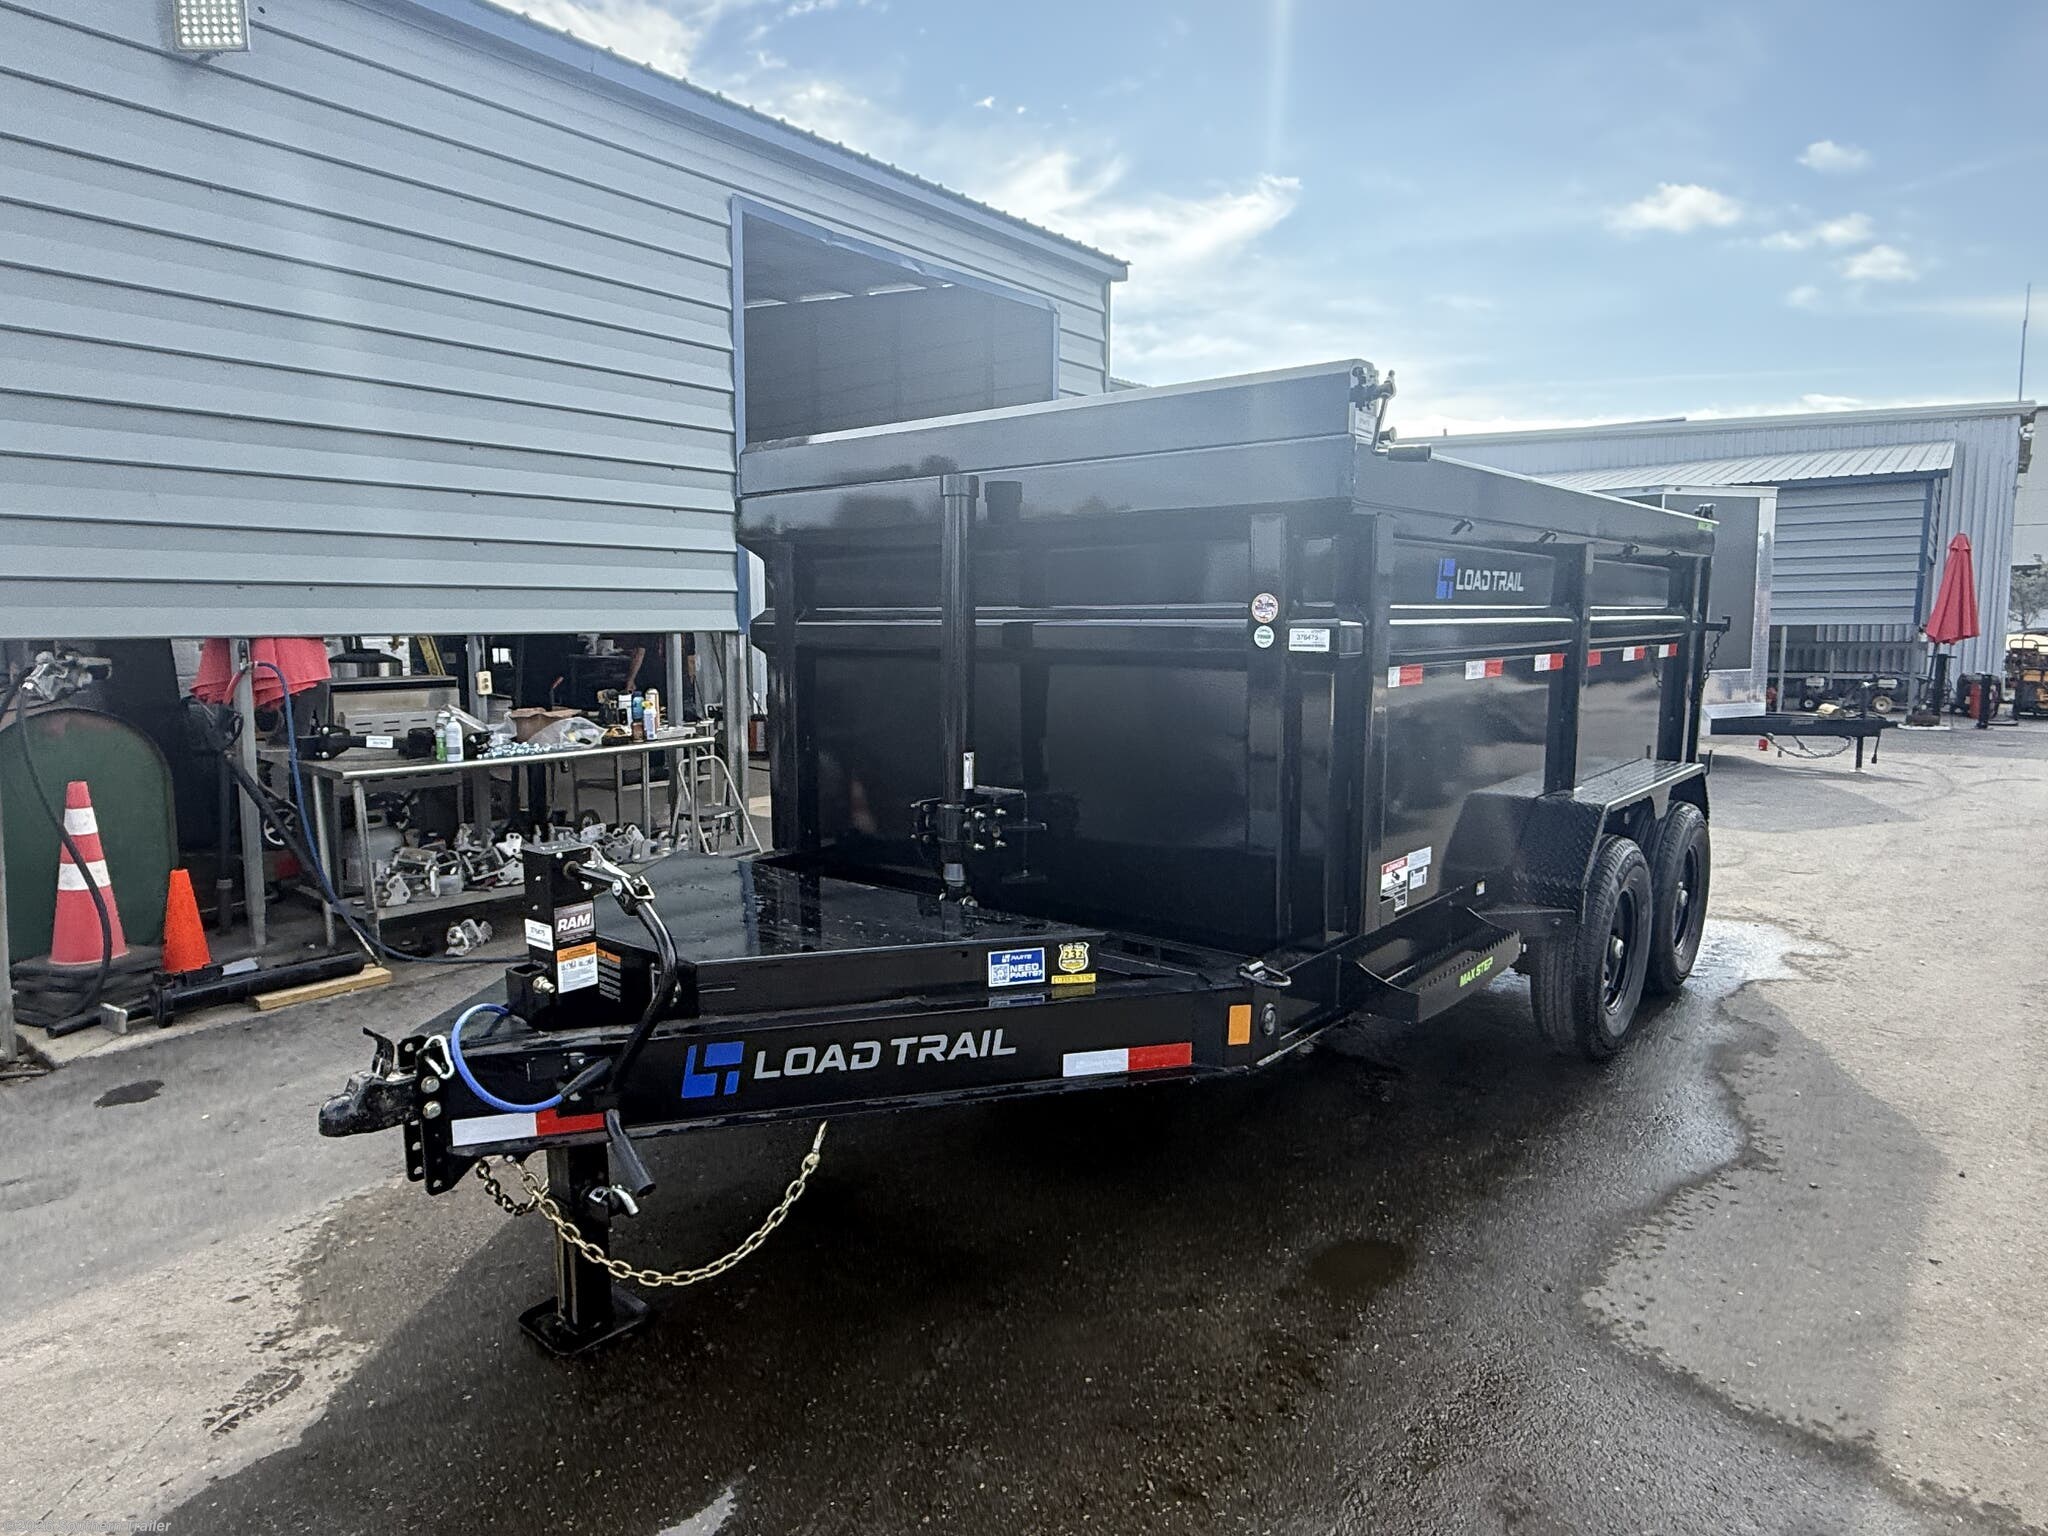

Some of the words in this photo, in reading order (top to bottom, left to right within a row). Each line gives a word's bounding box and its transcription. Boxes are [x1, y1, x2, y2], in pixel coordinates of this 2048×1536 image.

[1456, 568, 1491, 591] LOAD
[1492, 570, 1524, 592] TRAIL
[557, 912, 591, 932] RAM
[1064, 949, 1083, 959] 232
[1009, 962, 1040, 972] NEED
[1009, 969, 1043, 979] PARTS?
[1459, 968, 1475, 987] MAX
[1475, 955, 1494, 977] STEP
[753, 1041, 882, 1080] LOAD
[890, 1028, 1017, 1066] TRAIL
